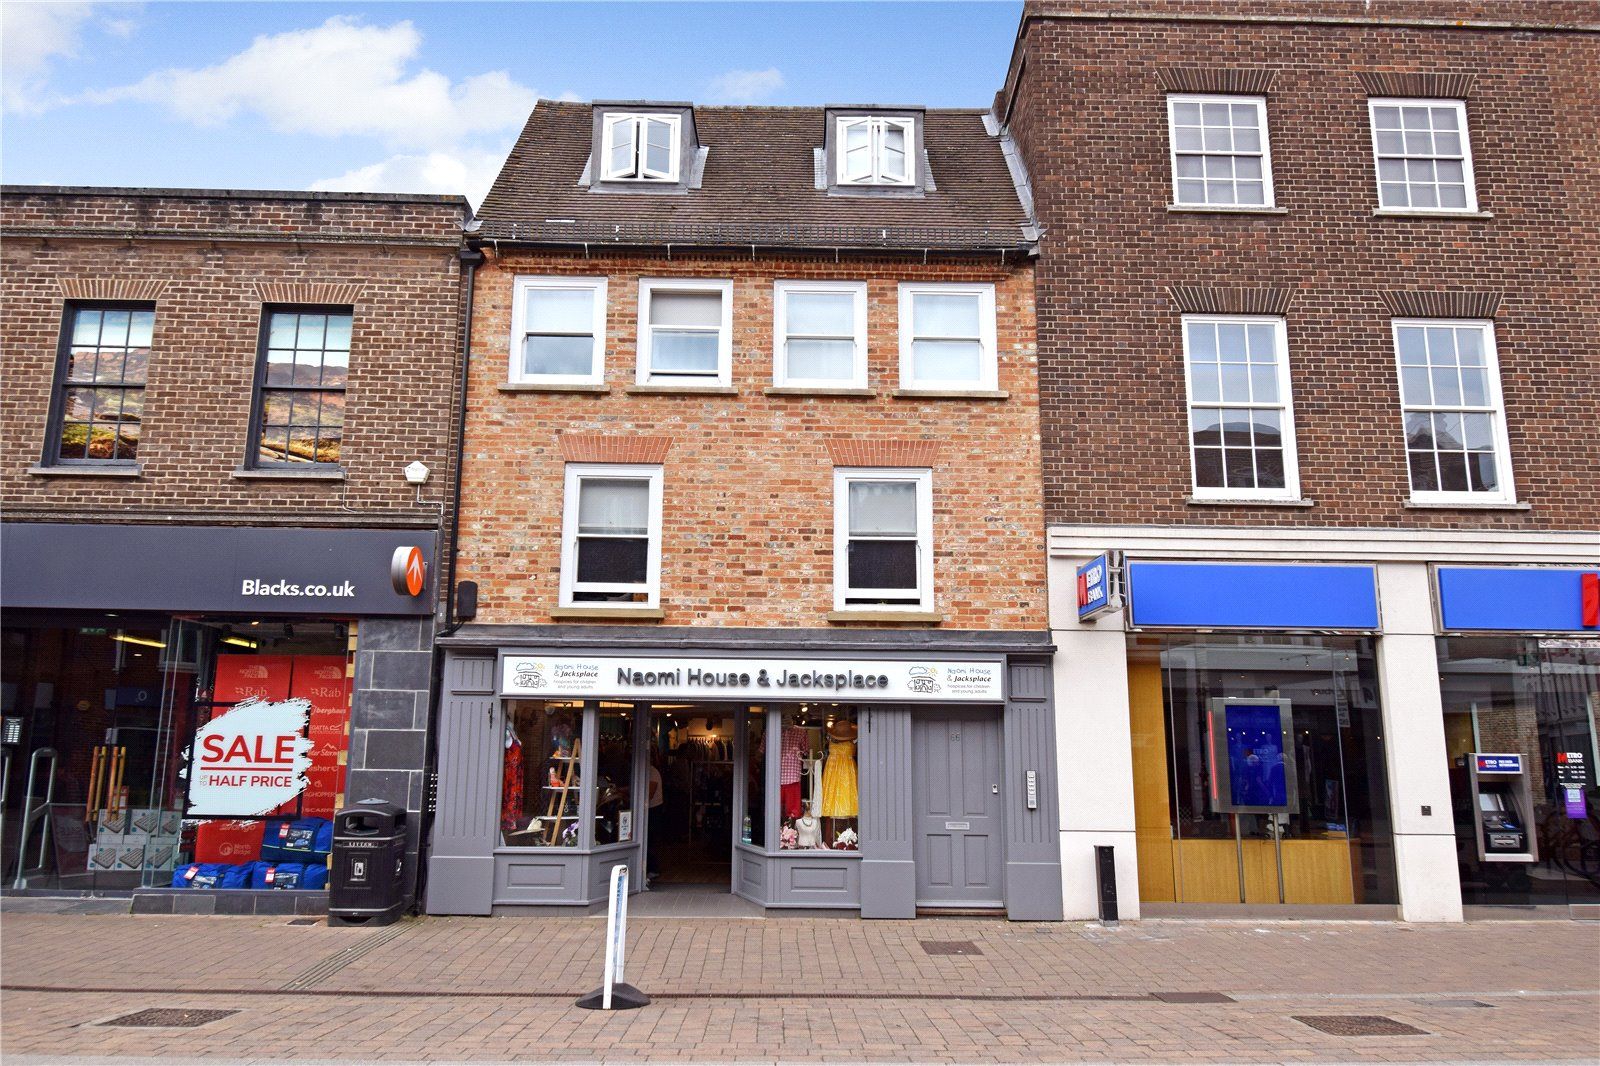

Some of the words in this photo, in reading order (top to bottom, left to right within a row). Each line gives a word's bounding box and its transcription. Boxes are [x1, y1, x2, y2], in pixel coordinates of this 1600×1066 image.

[242, 579, 355, 597] Blacks.co.uk
[617, 668, 680, 685] Naomi
[688, 668, 750, 685] House
[757, 669, 771, 686] &
[777, 670, 889, 691] Jacksplace
[320, 688, 341, 697] Rab
[201, 734, 296, 763] SALE
[209, 775, 247, 787] HALF
[251, 776, 292, 787] PRICE
